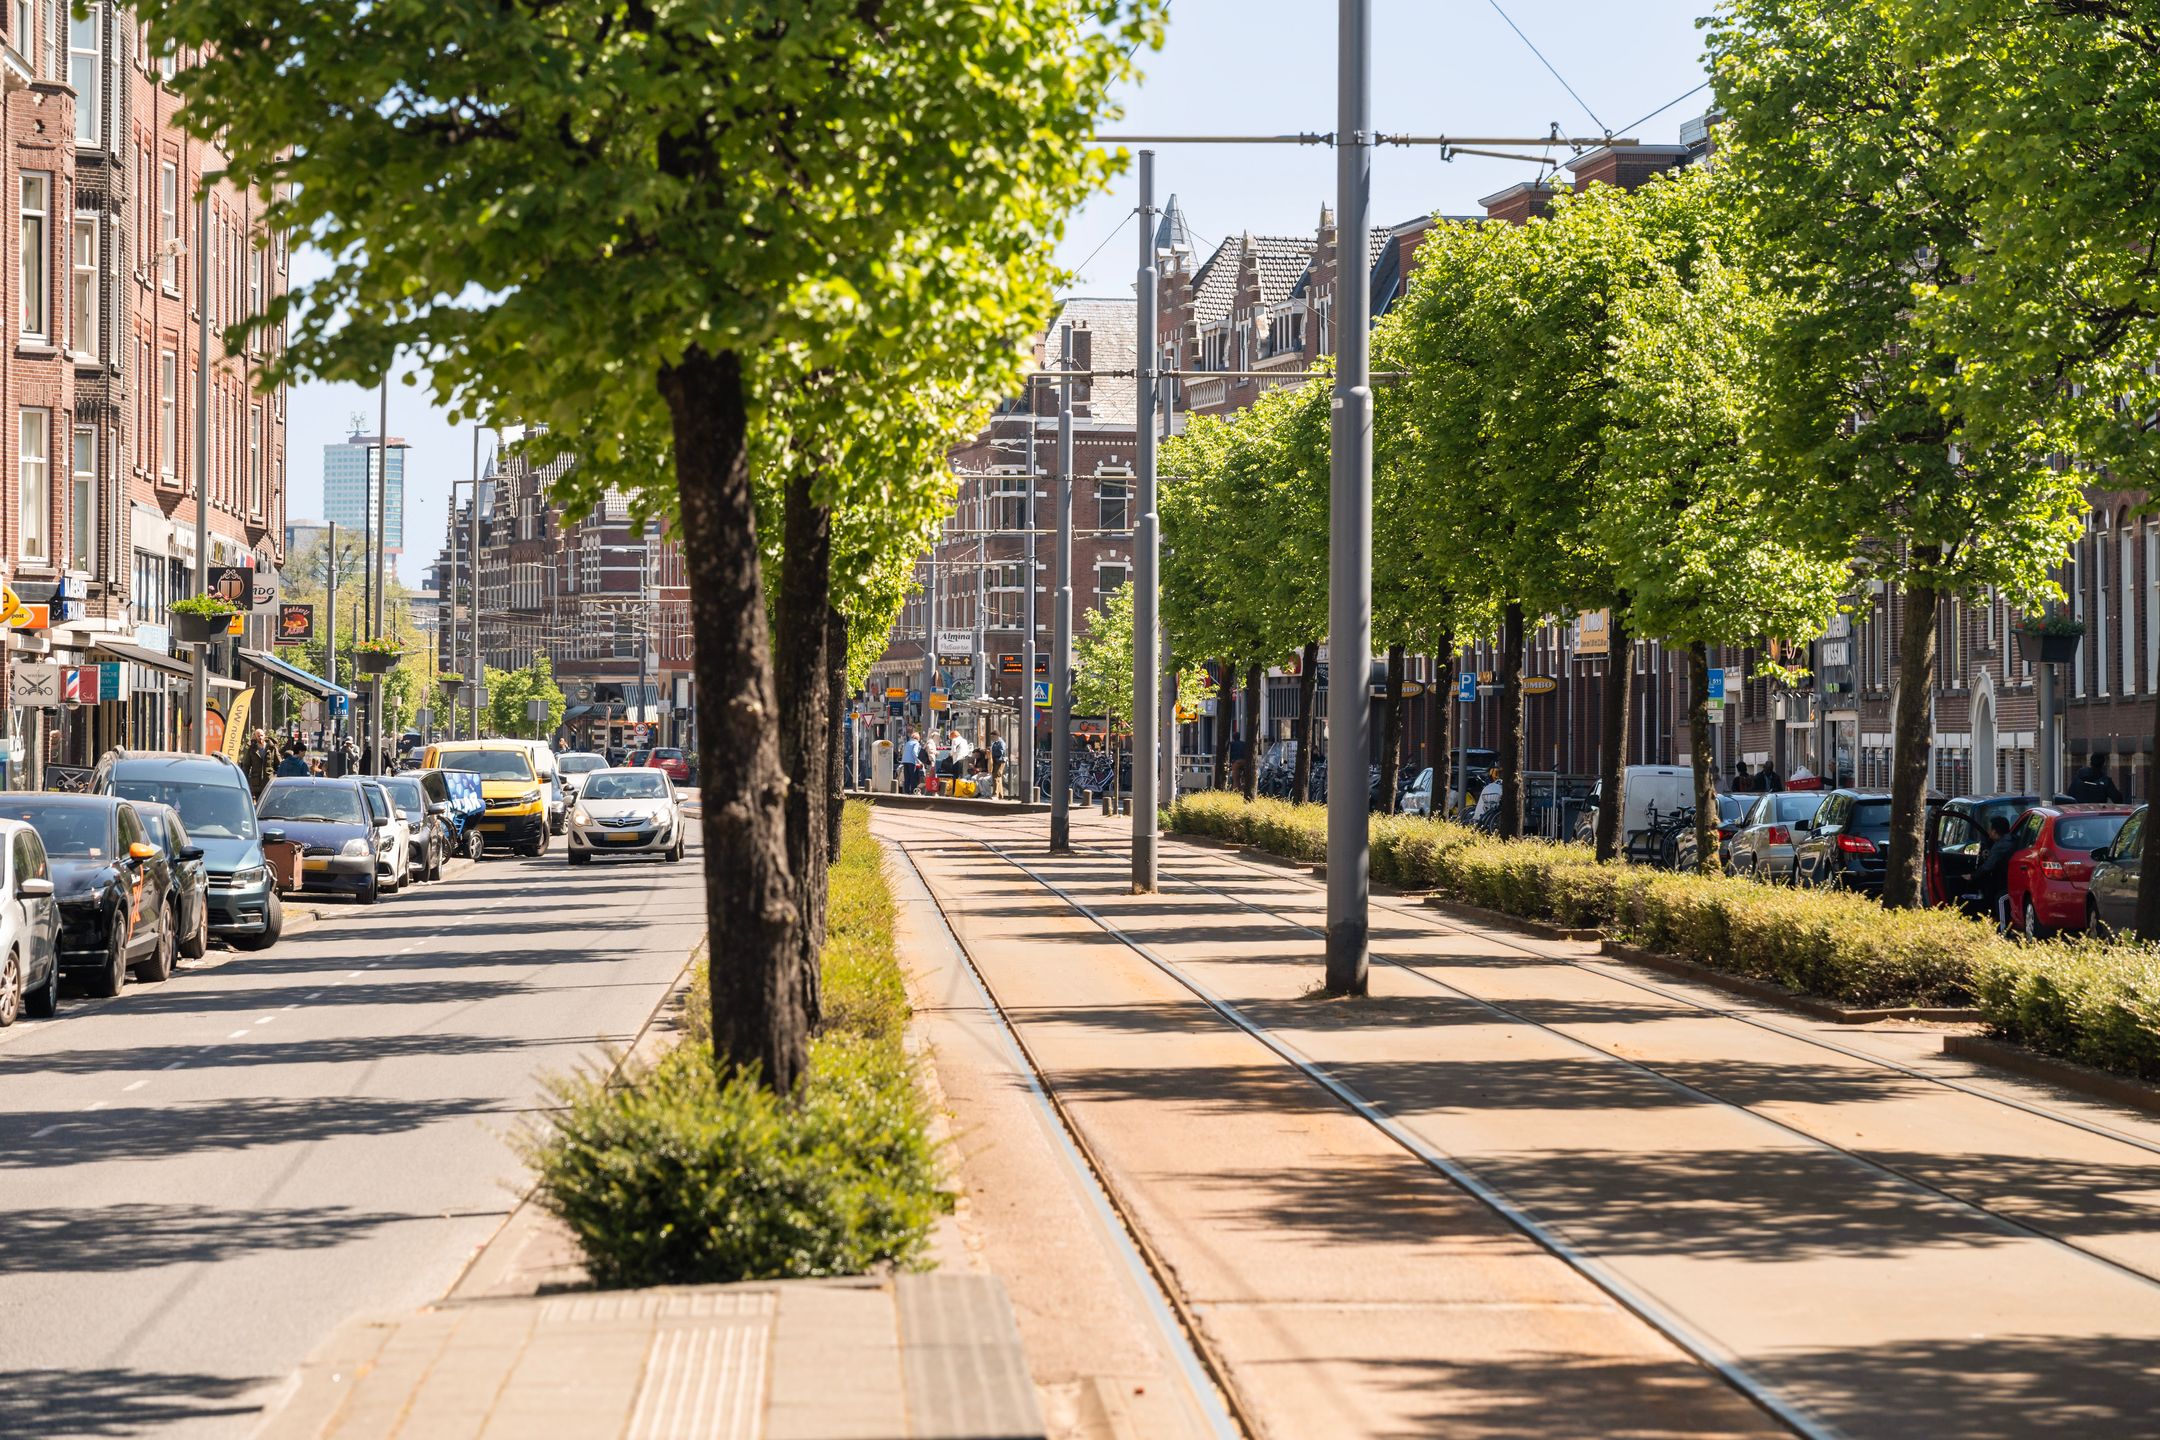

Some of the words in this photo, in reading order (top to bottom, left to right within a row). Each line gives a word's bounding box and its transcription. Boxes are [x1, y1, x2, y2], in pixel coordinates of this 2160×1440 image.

[940, 632, 971, 642] Almina
[1462, 675, 1472, 689] P
[336, 695, 345, 707] P
